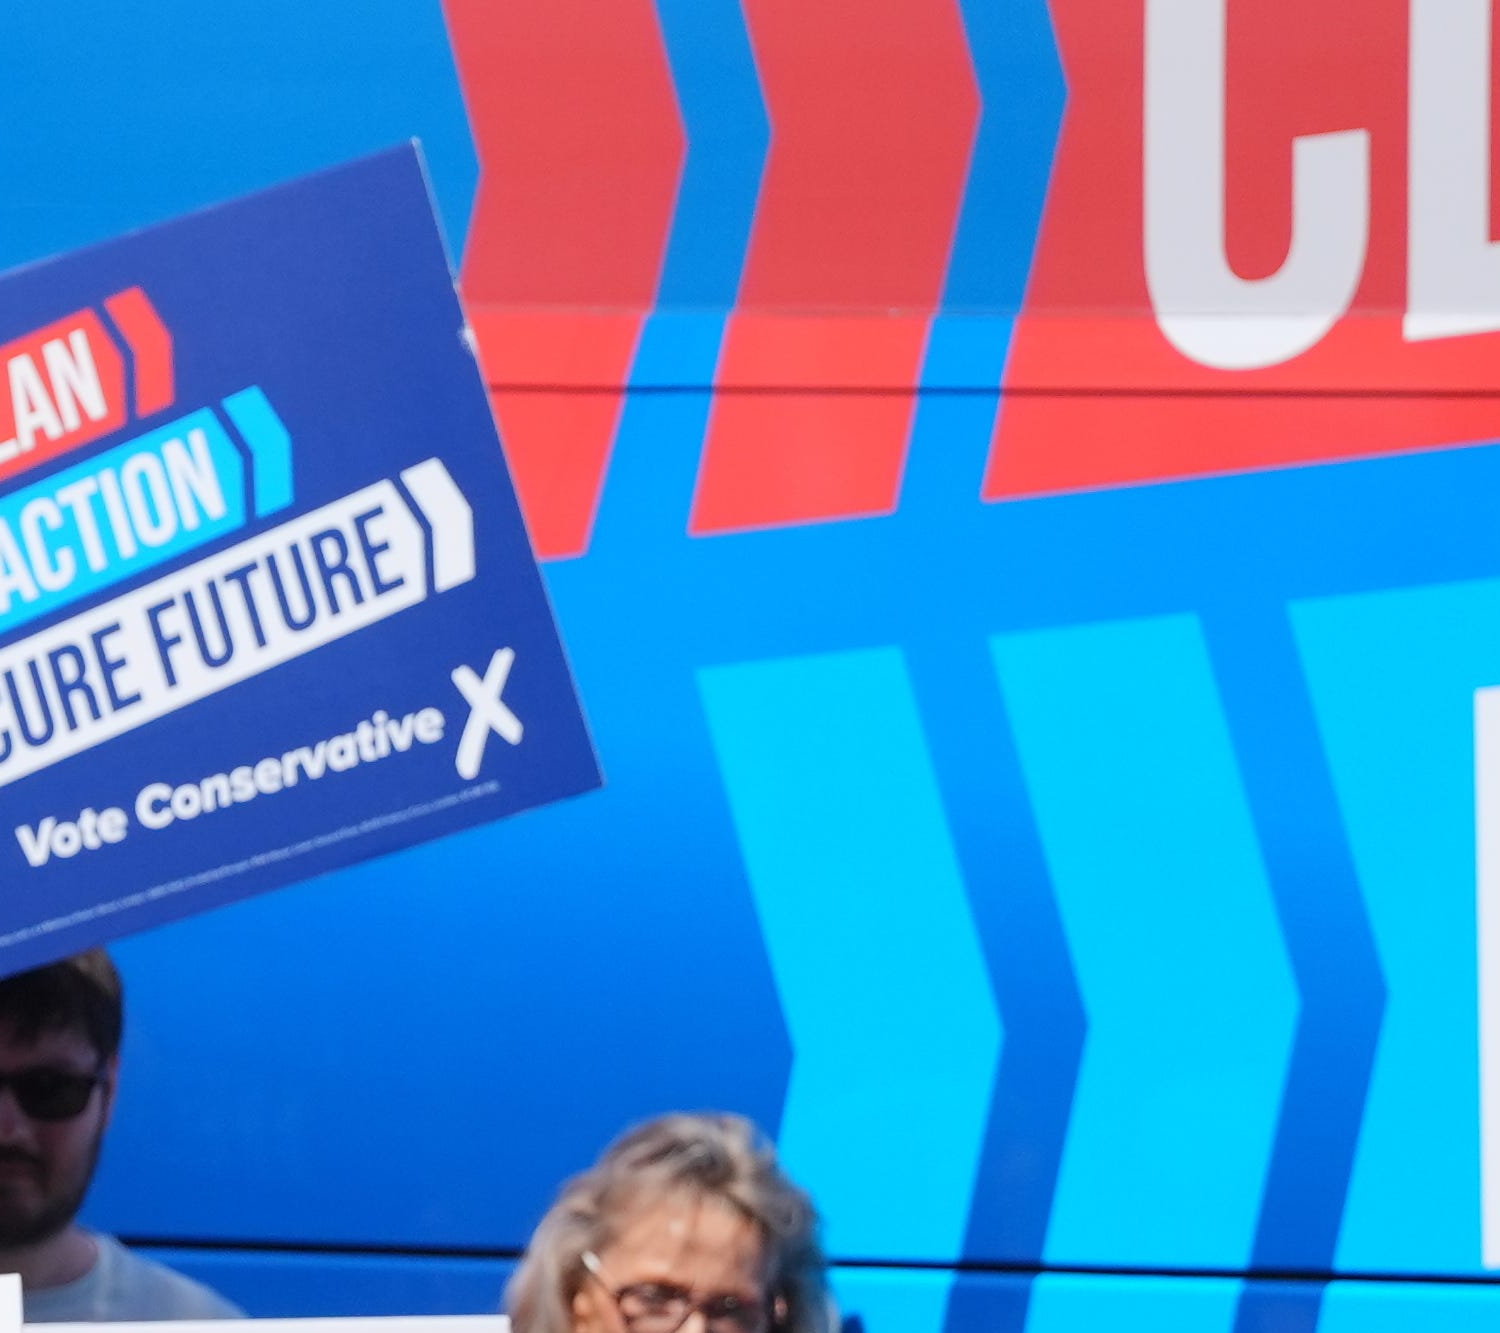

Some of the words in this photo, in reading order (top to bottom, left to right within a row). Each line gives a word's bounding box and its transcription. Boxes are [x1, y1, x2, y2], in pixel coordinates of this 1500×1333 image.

[148, 504, 405, 712] FUTURE
[14, 808, 126, 868] Vote
[135, 699, 444, 832] Conservative
